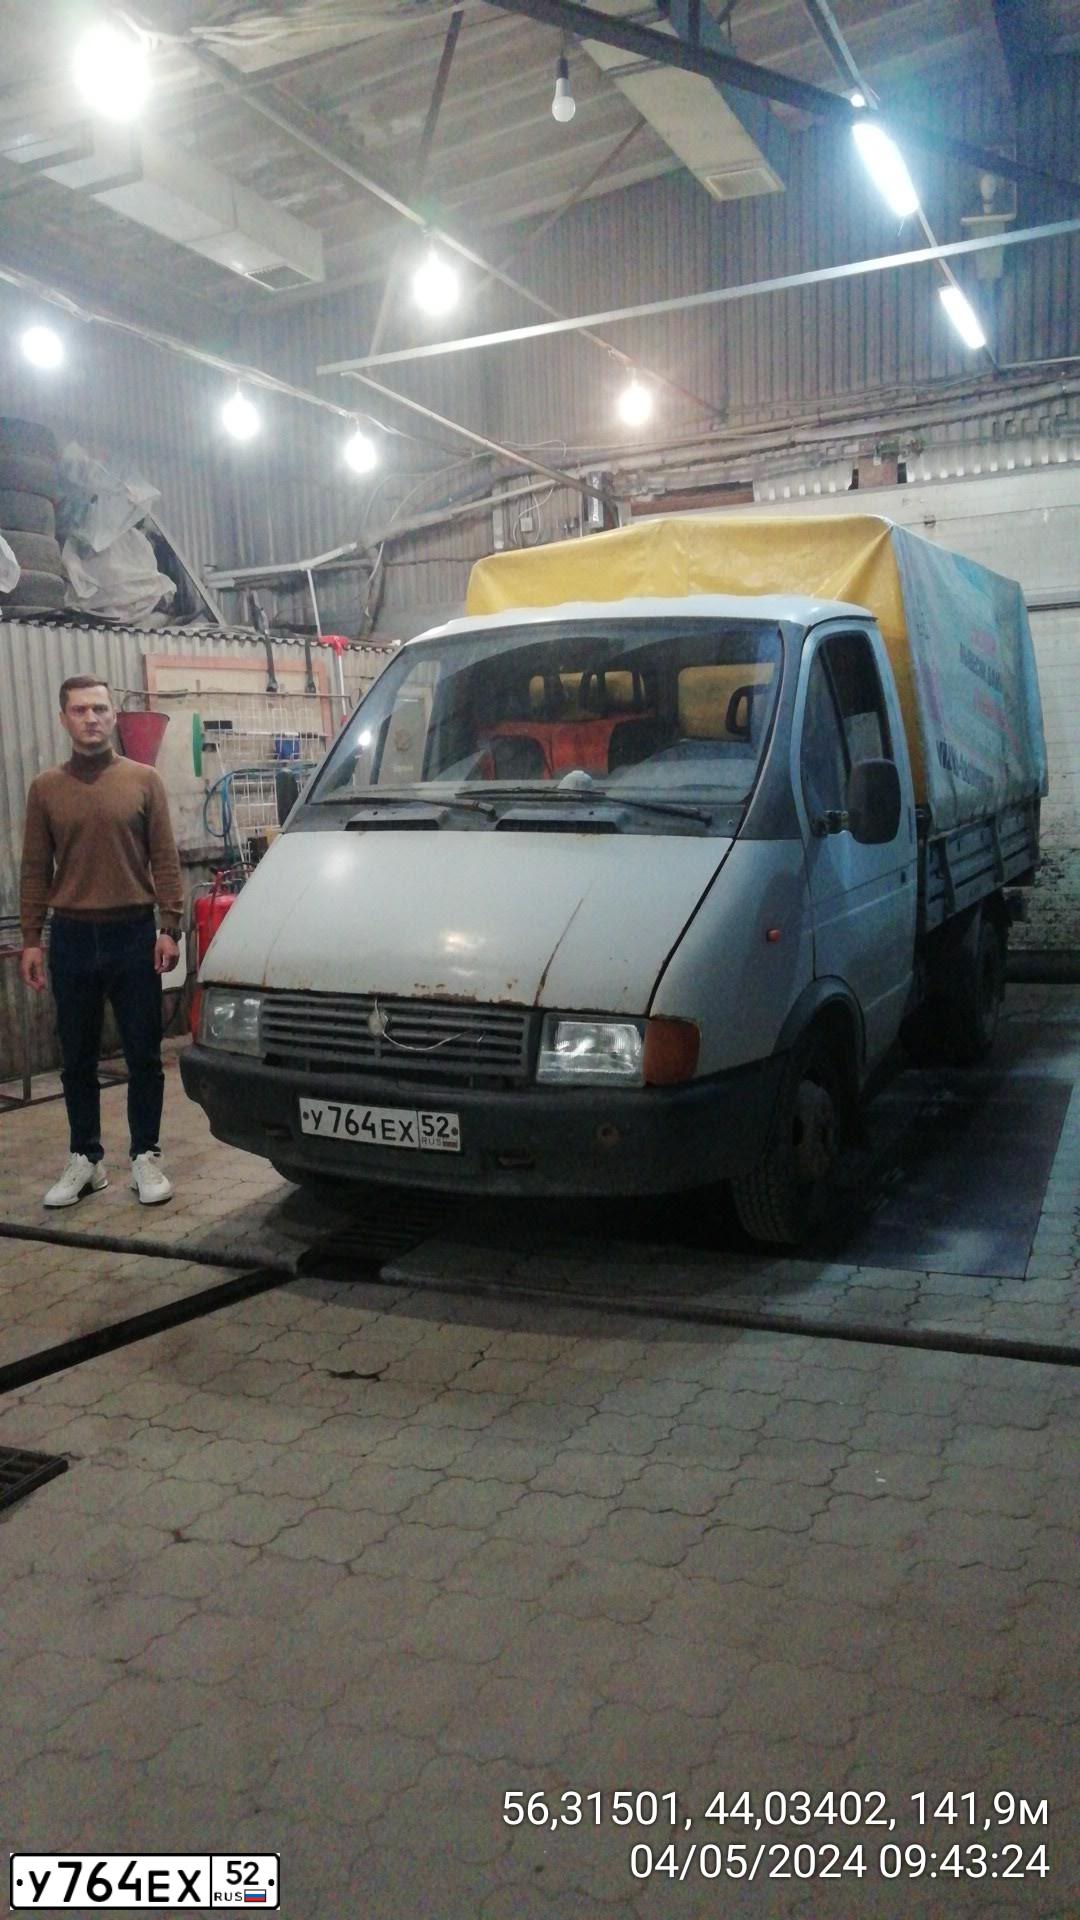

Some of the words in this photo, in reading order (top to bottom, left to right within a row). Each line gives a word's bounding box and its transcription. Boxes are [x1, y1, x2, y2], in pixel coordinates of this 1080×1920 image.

[311, 1106, 415, 1143] У764ЕХ
[421, 1115, 450, 1138] 52
[421, 1136, 442, 1146] RUS
